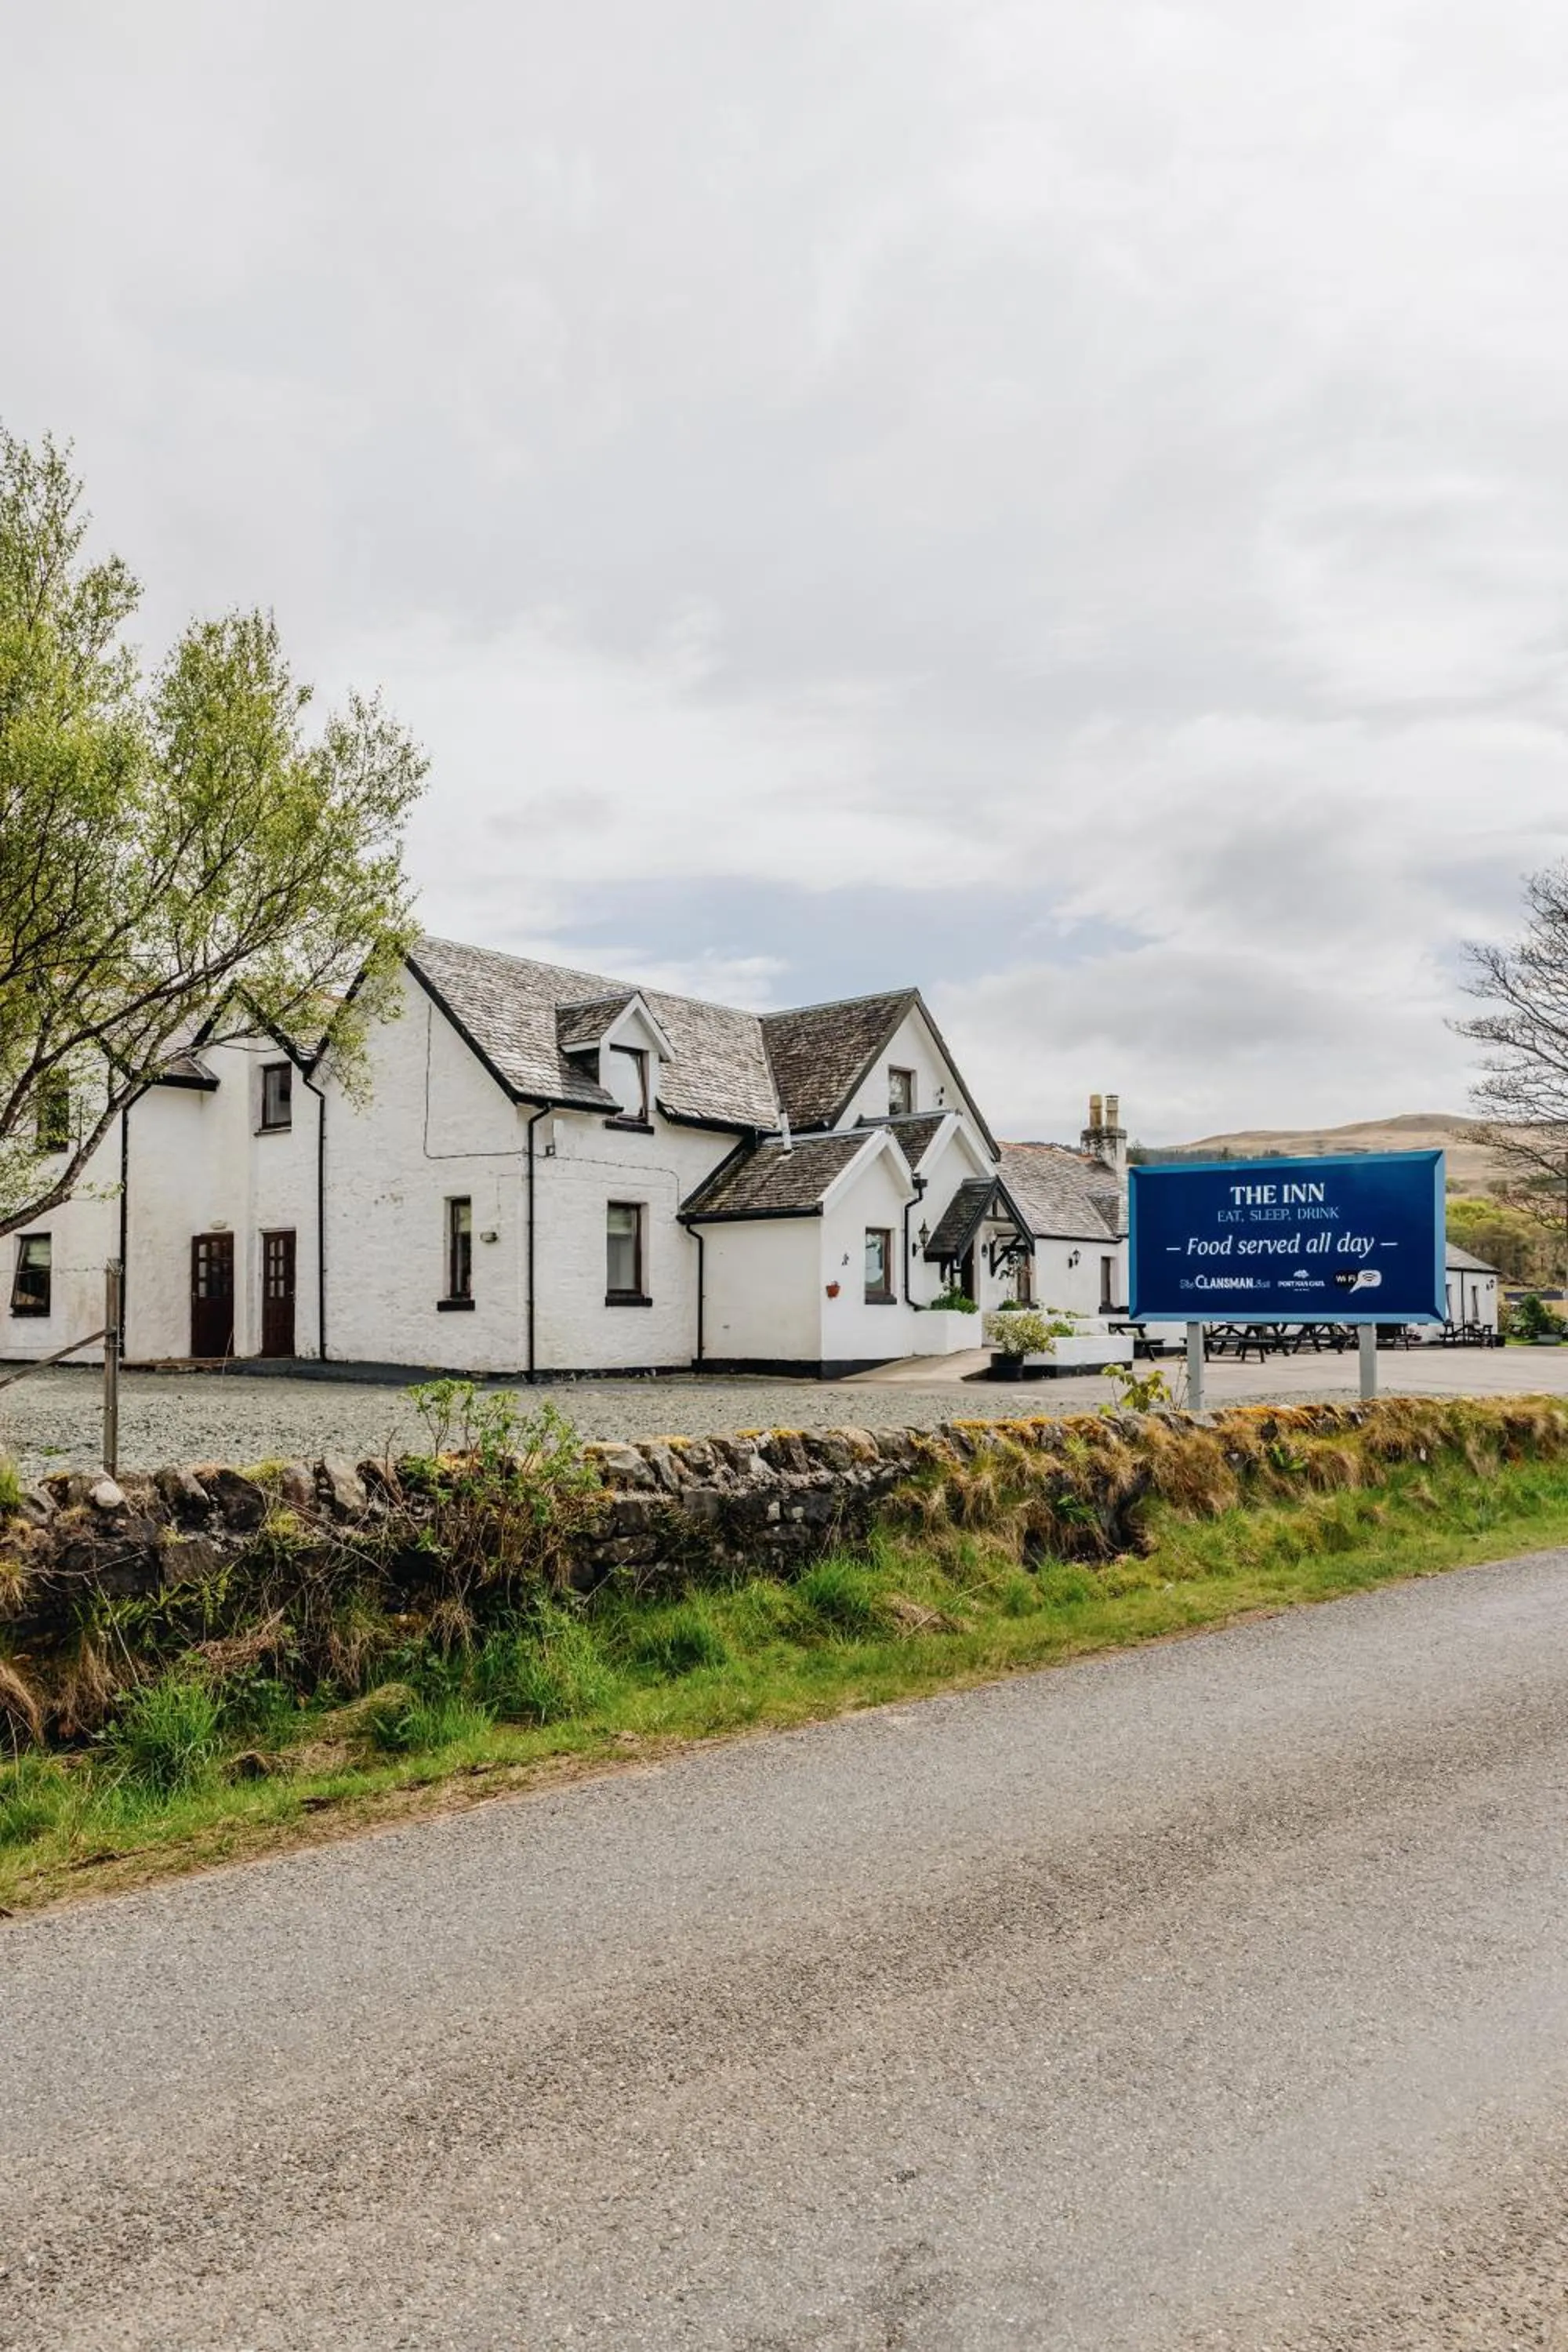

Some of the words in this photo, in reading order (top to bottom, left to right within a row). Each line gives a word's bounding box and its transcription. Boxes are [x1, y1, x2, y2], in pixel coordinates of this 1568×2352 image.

[1229, 1185, 1276, 1205] THE
[1283, 1182, 1325, 1203] INN
[1218, 1210, 1244, 1222] EAT,
[1250, 1208, 1291, 1221] SLEEP,
[1298, 1206, 1340, 1220] DRINK
[1187, 1235, 1233, 1255] Food
[1236, 1232, 1301, 1254] served
[1305, 1232, 1332, 1254] all
[1337, 1232, 1375, 1259] day
[1195, 1274, 1254, 1289] CLANSMAN
